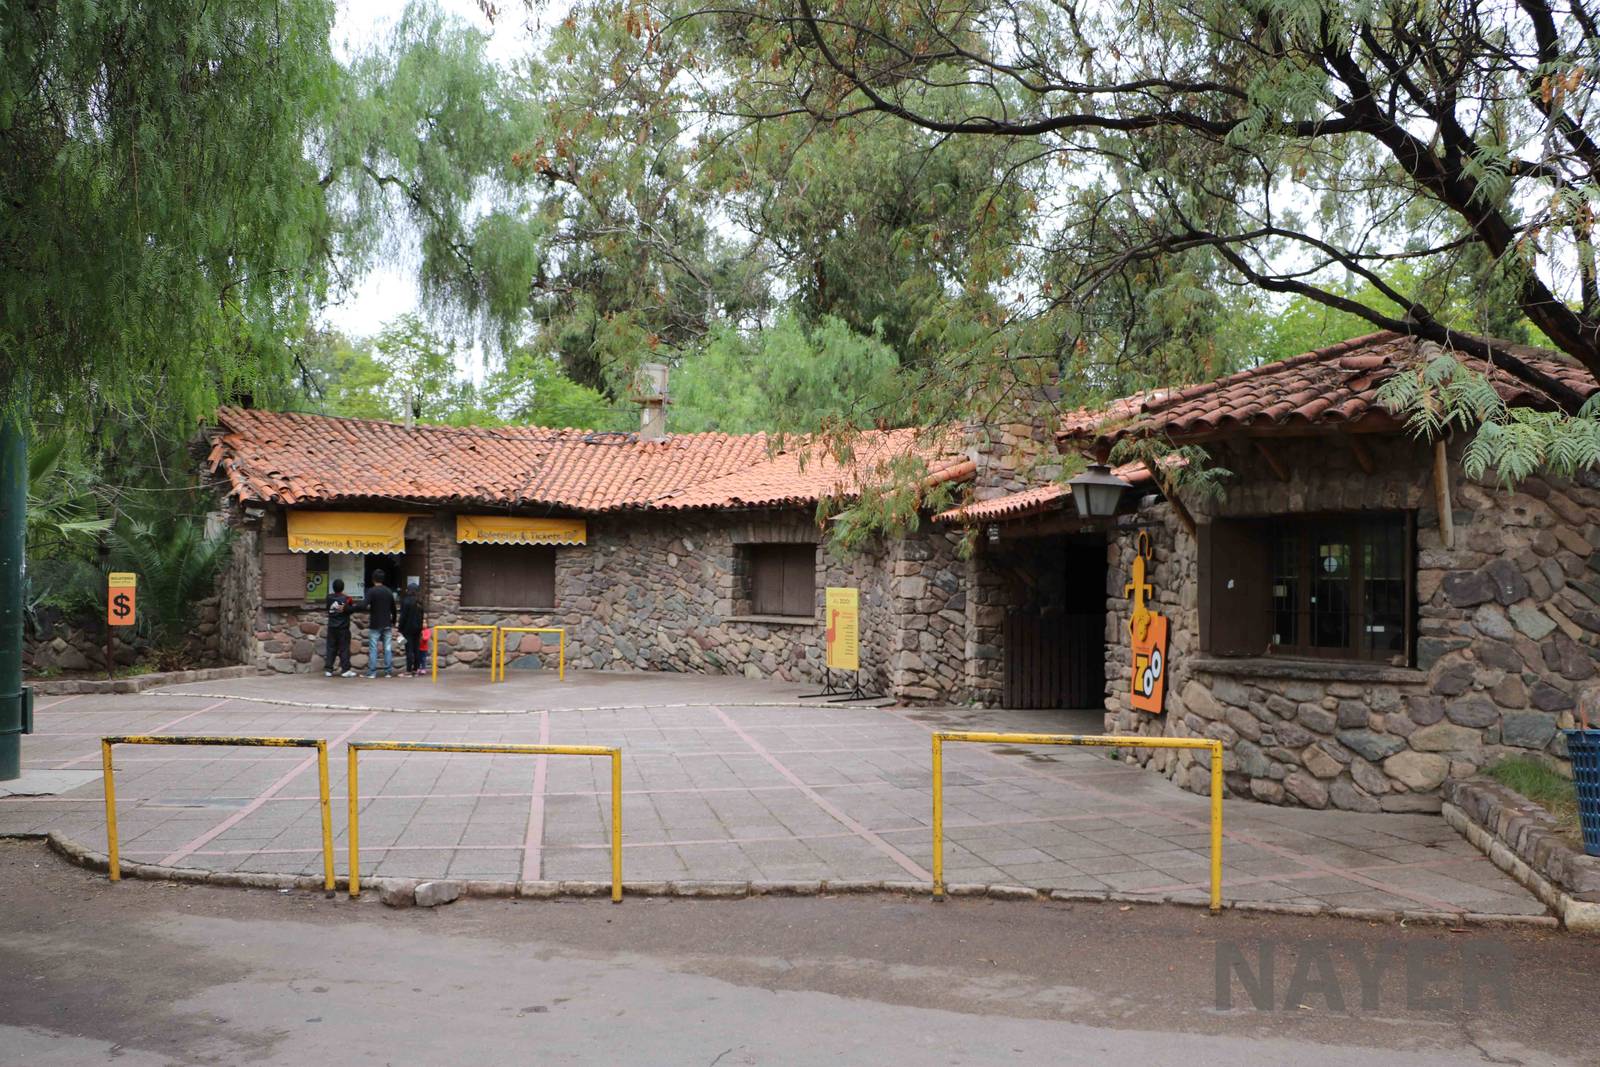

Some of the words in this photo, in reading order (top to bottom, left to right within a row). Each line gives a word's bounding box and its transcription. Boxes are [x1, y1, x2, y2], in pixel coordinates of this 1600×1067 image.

[355, 540, 385, 549] Tickets
[530, 532, 561, 540] Tickets
[113, 593, 131, 619] $
[1134, 647, 1162, 700] ZOO
